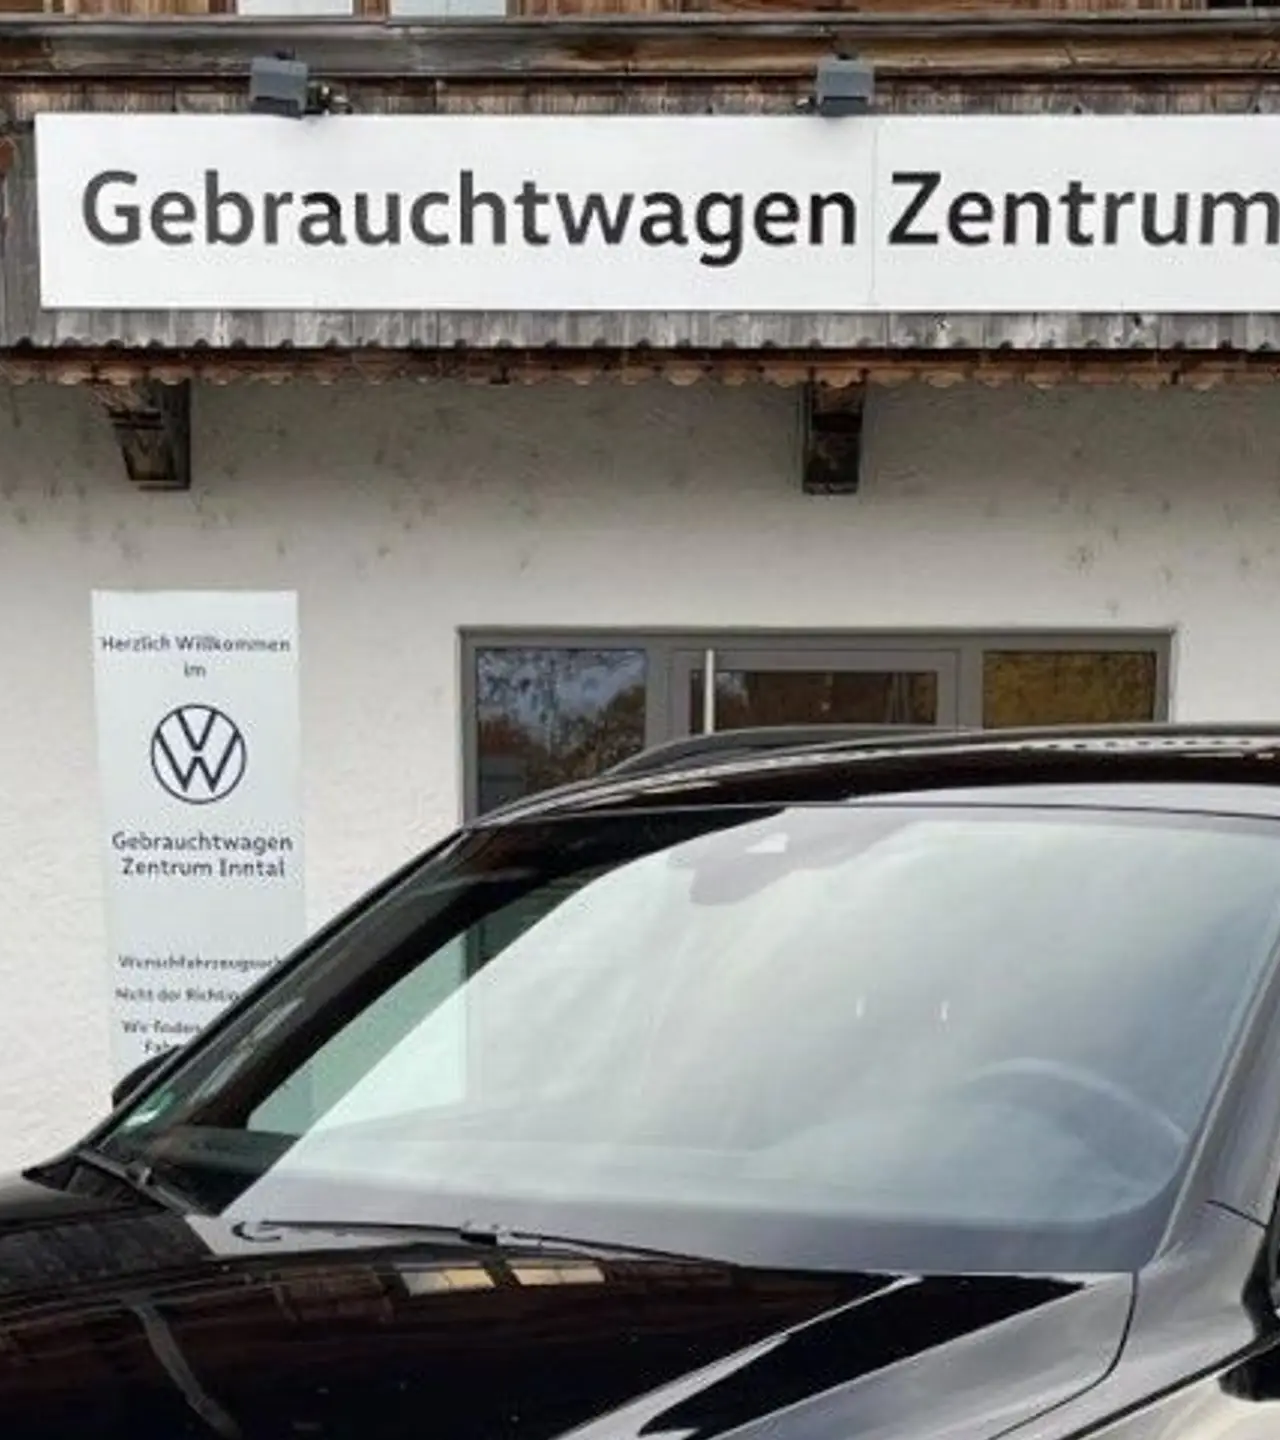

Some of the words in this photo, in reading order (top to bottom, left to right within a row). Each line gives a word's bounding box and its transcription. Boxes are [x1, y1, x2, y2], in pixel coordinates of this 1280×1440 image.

[82, 169, 858, 268] Gebrauchtwagen
[101, 635, 171, 652] Herzlich
[175, 634, 291, 652] Willkommen
[182, 660, 208, 678] im
[111, 830, 294, 857] Gebrauchtwagen
[121, 857, 213, 879] Zentrum
[219, 857, 286, 878] Inntal
[118, 954, 282, 972] Wunschfahrzeugsuch
